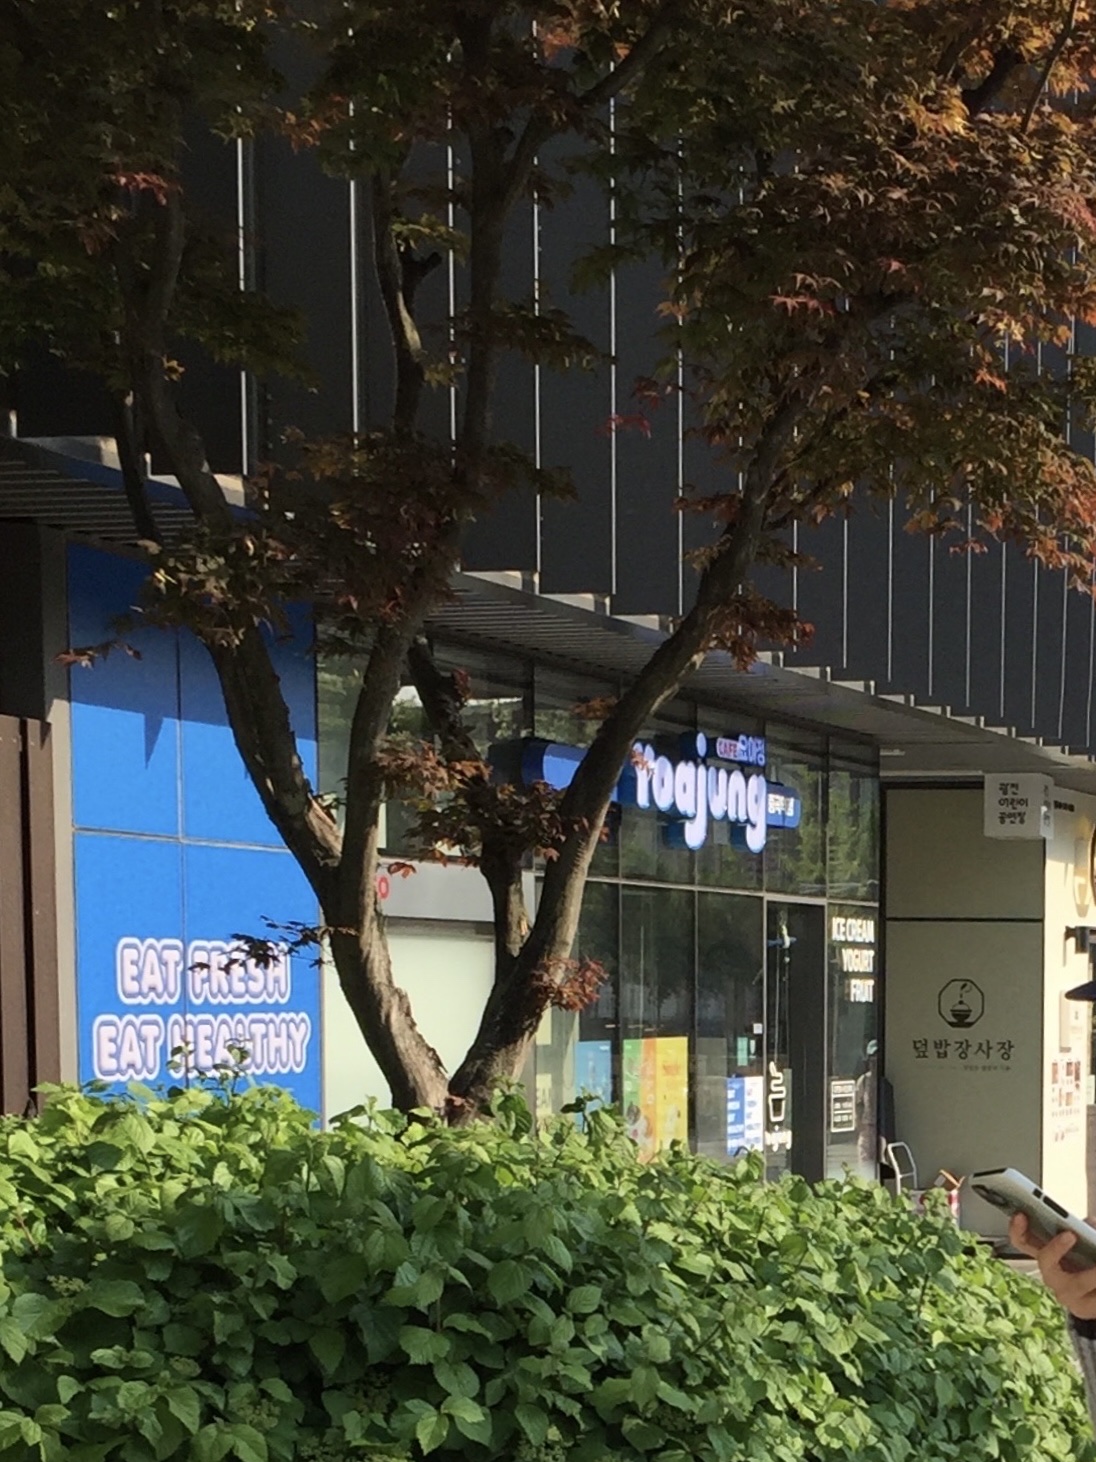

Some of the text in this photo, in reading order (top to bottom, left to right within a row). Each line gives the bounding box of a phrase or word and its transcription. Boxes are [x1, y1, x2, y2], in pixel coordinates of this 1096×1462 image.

[998, 798, 1028, 810] 어린이
[832, 916, 875, 943] ICE CREAM
[117, 937, 291, 1004] EAT FRESH
[841, 948, 875, 973] YOGURT
[850, 979, 875, 1003] FRUIT
[93, 1014, 165, 1081] EAT
[912, 1038, 1015, 1061] 덮밥장사장
